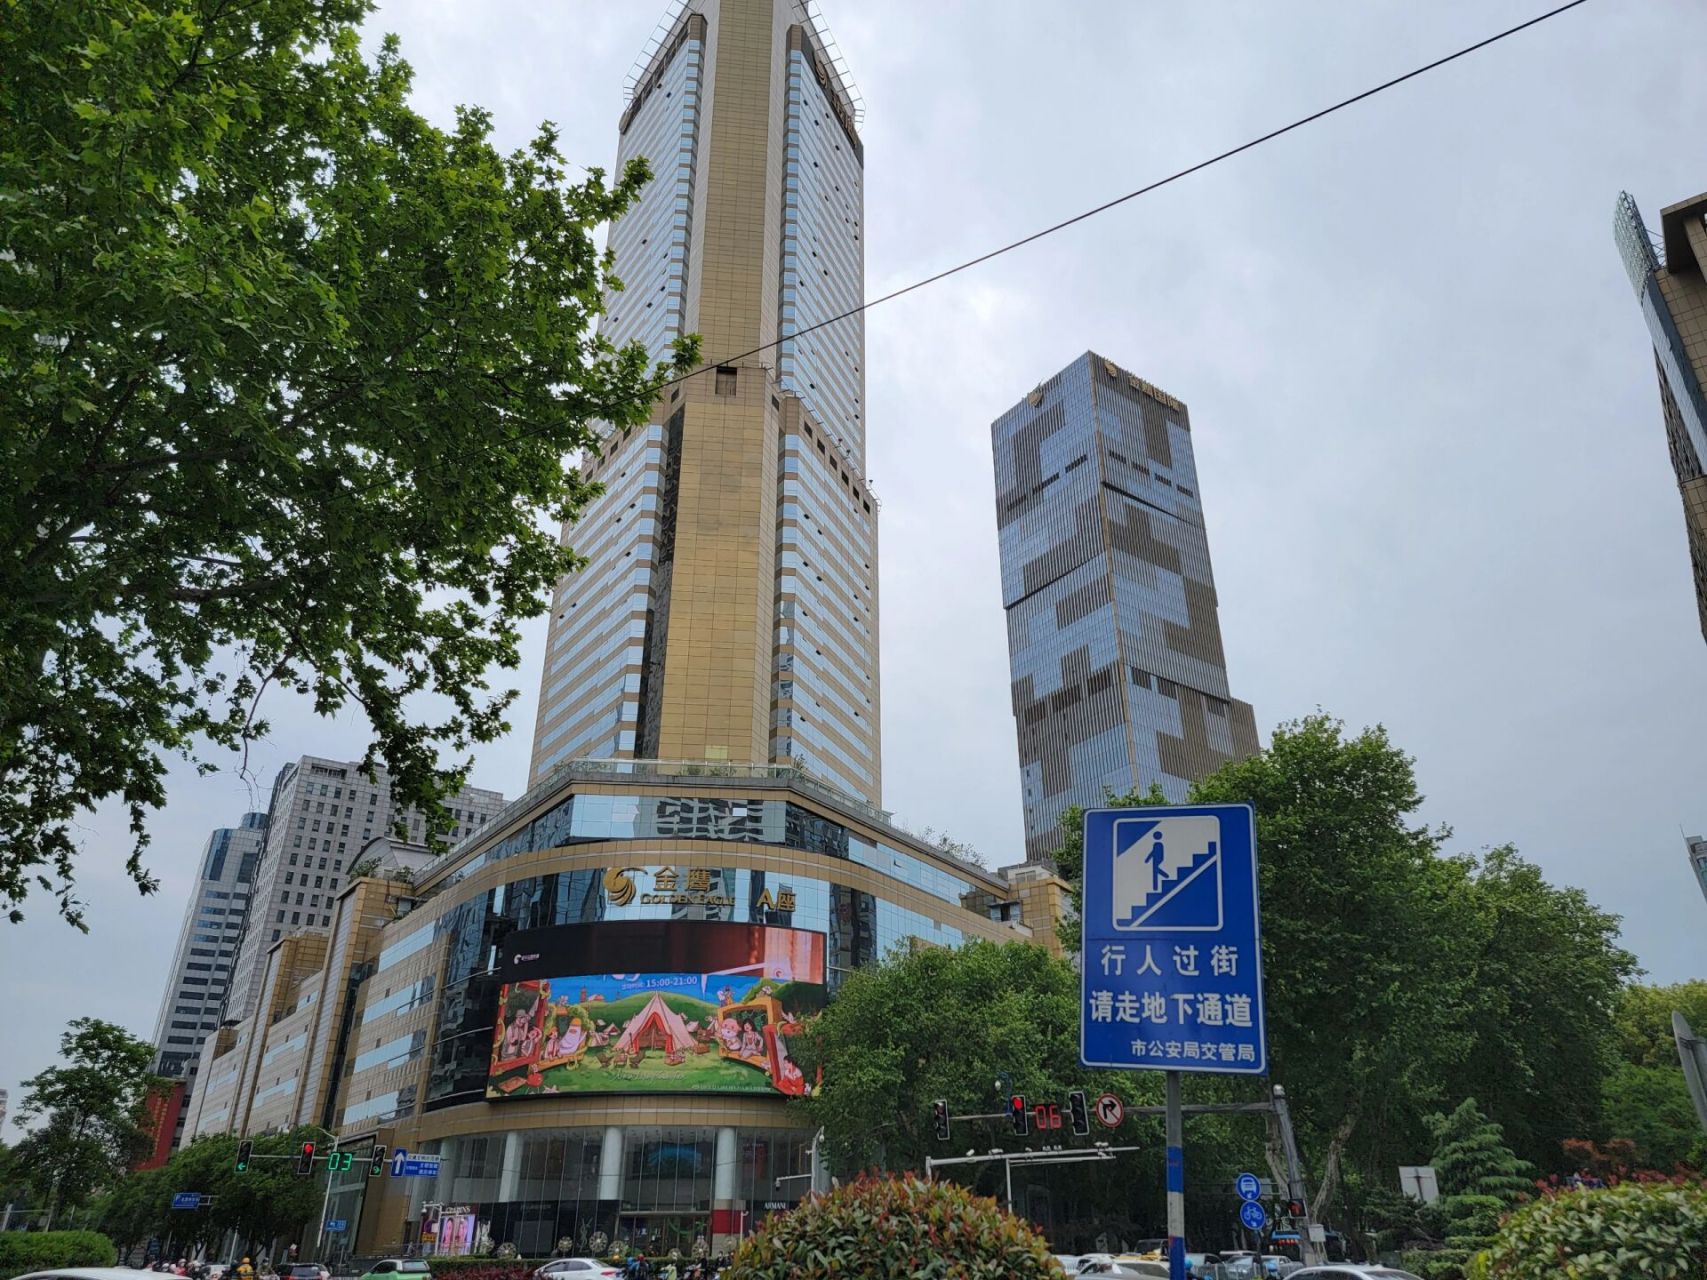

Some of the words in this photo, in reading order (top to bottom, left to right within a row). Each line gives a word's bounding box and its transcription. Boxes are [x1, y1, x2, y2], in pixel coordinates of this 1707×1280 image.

[653, 866, 711, 892] 金鹰
[756, 887, 797, 912] A座
[1101, 944, 1239, 977] 行人过街
[646, 976, 698, 988] 15:00-21:00
[1089, 989, 1253, 1027] 请走地下通道
[1131, 1039, 1256, 1062] 市公安局交管局
[1034, 1105, 1062, 1129] 06
[327, 1152, 353, 1172] 03
[763, 1202, 787, 1210] ARMANI
